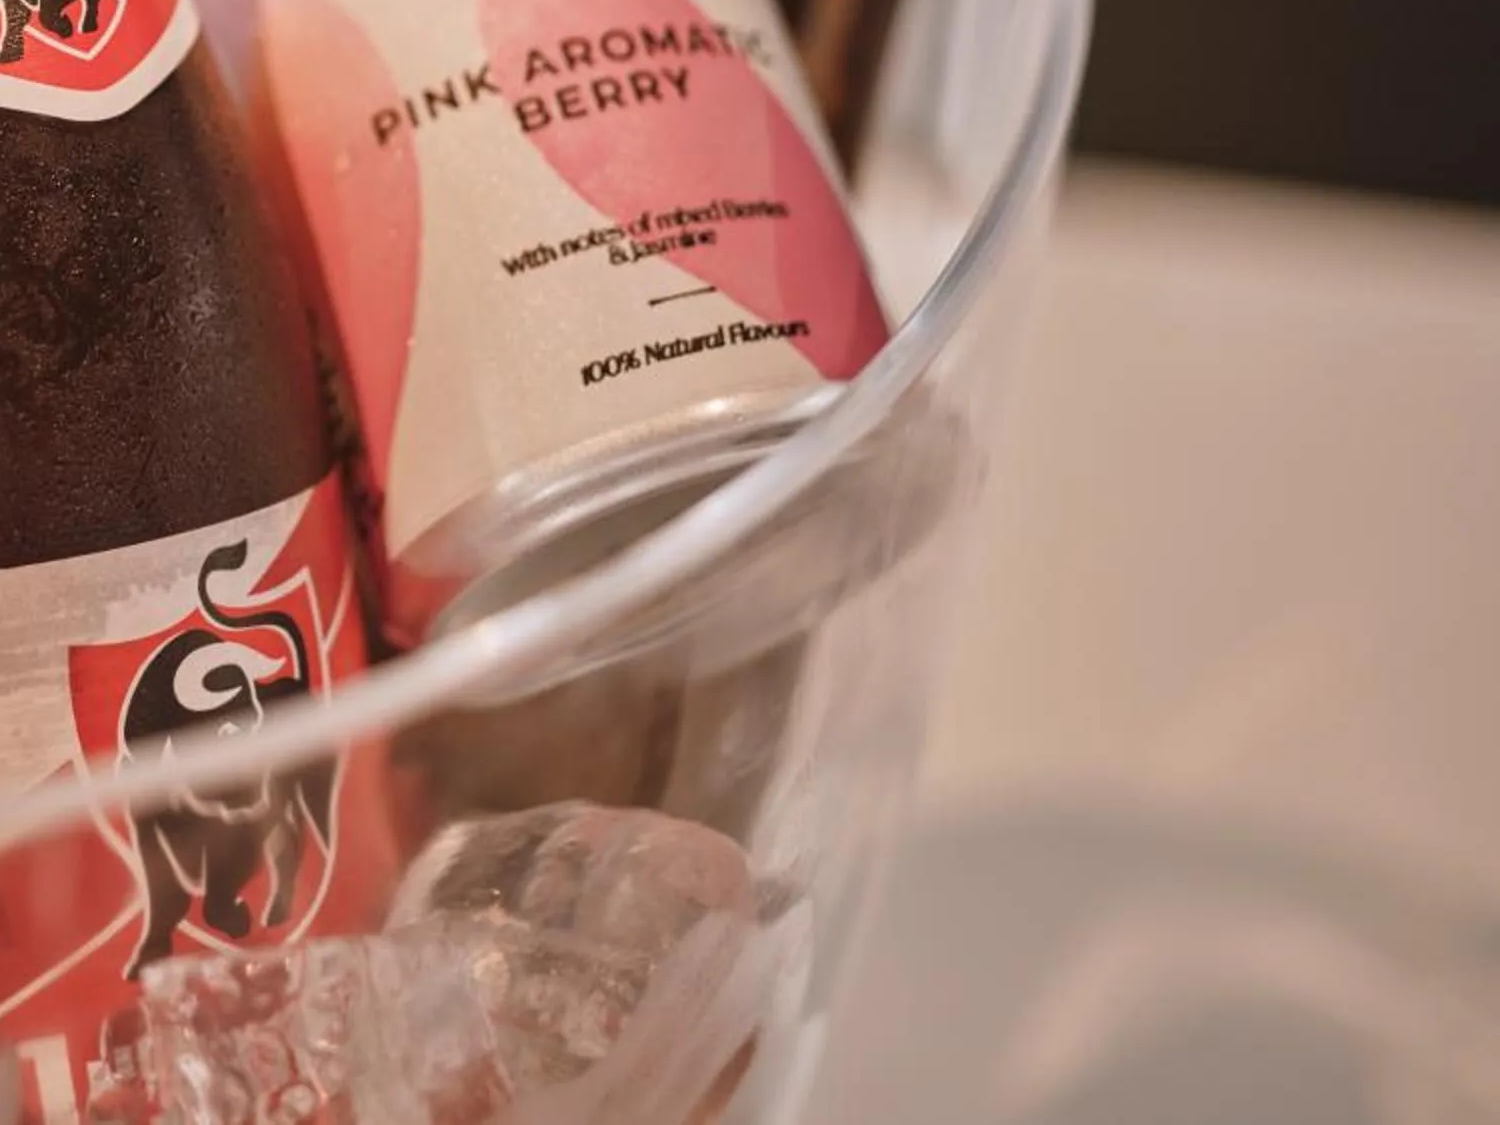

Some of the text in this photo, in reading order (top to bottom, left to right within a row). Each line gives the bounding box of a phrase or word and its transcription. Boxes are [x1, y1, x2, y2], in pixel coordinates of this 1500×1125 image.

[370, 64, 502, 147] PINK
[512, 67, 692, 135] BERRY
[560, 222, 626, 259] notes
[627, 210, 650, 237] of
[608, 243, 629, 265] &
[580, 350, 641, 386] 100%
[644, 325, 725, 365] Natural
